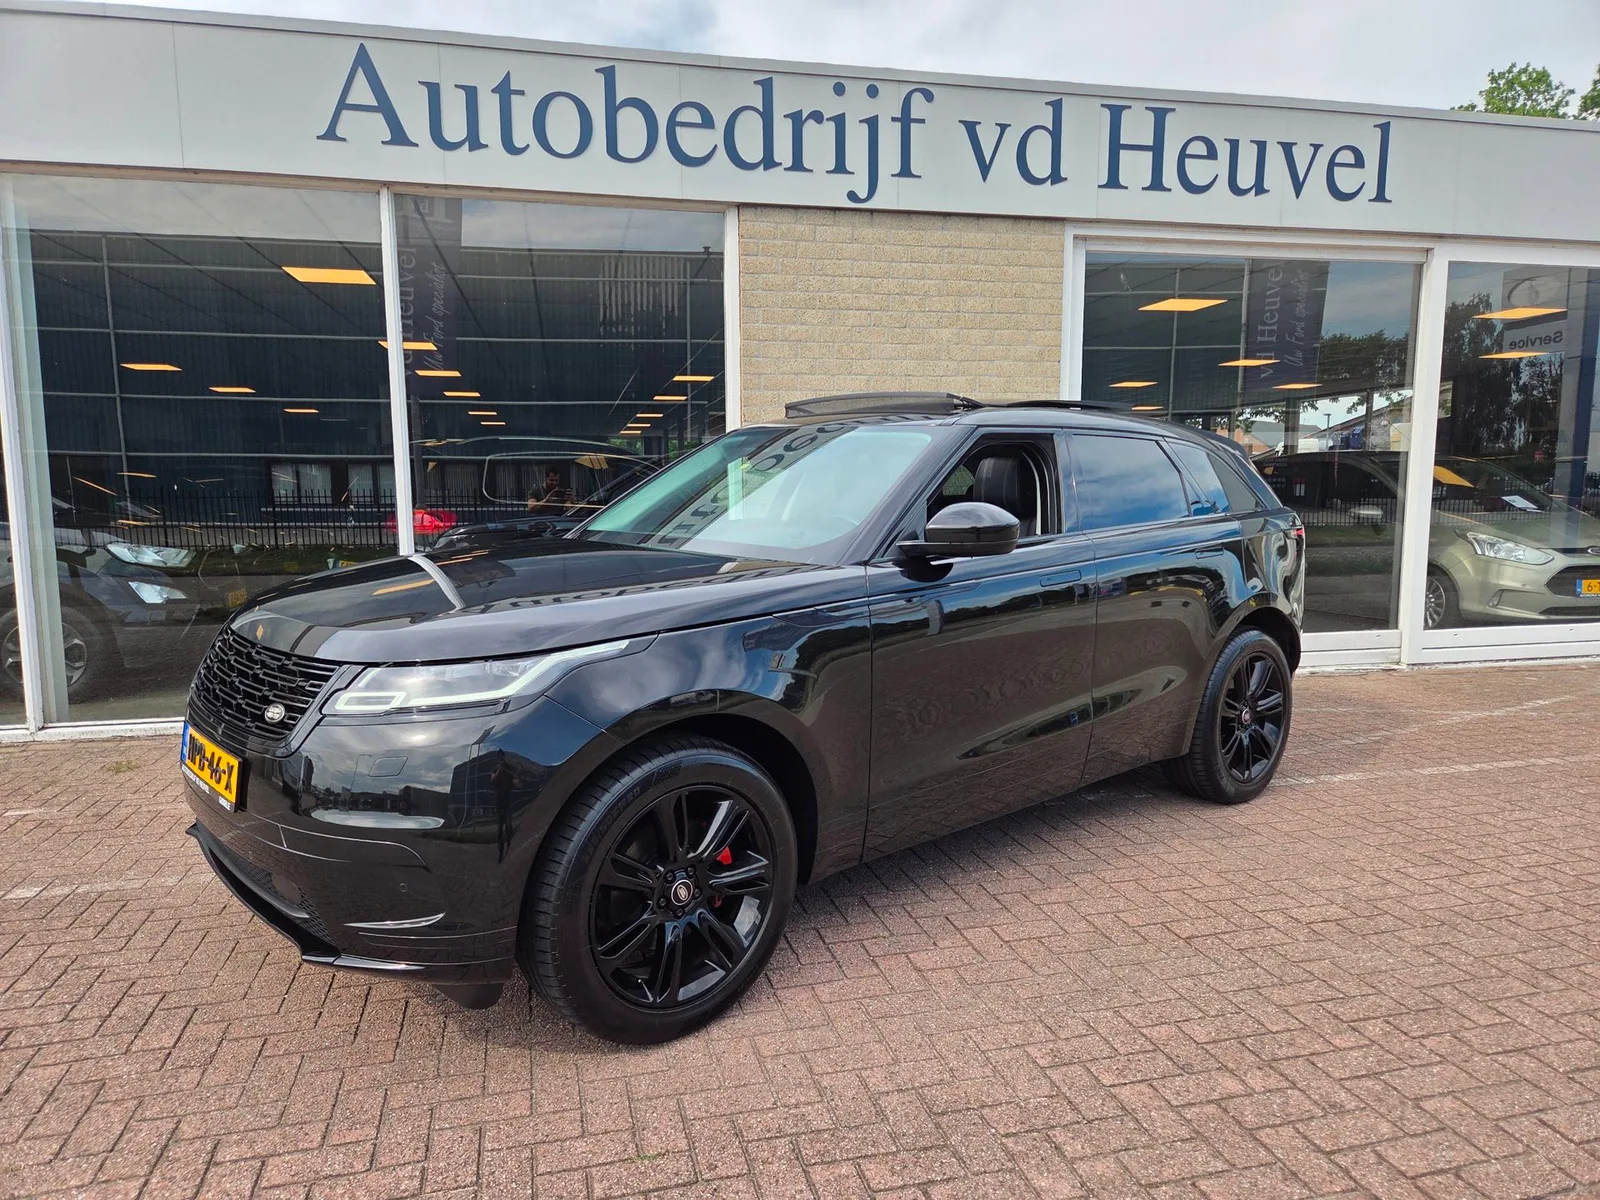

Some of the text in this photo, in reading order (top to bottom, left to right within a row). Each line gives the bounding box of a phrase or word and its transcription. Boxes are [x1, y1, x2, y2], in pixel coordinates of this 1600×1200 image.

[318, 43, 1392, 205] Autobedrijf vd Heuvel
[424, 262, 451, 316] specialist
[422, 315, 444, 348] Ford
[1285, 319, 1306, 345] Ford
